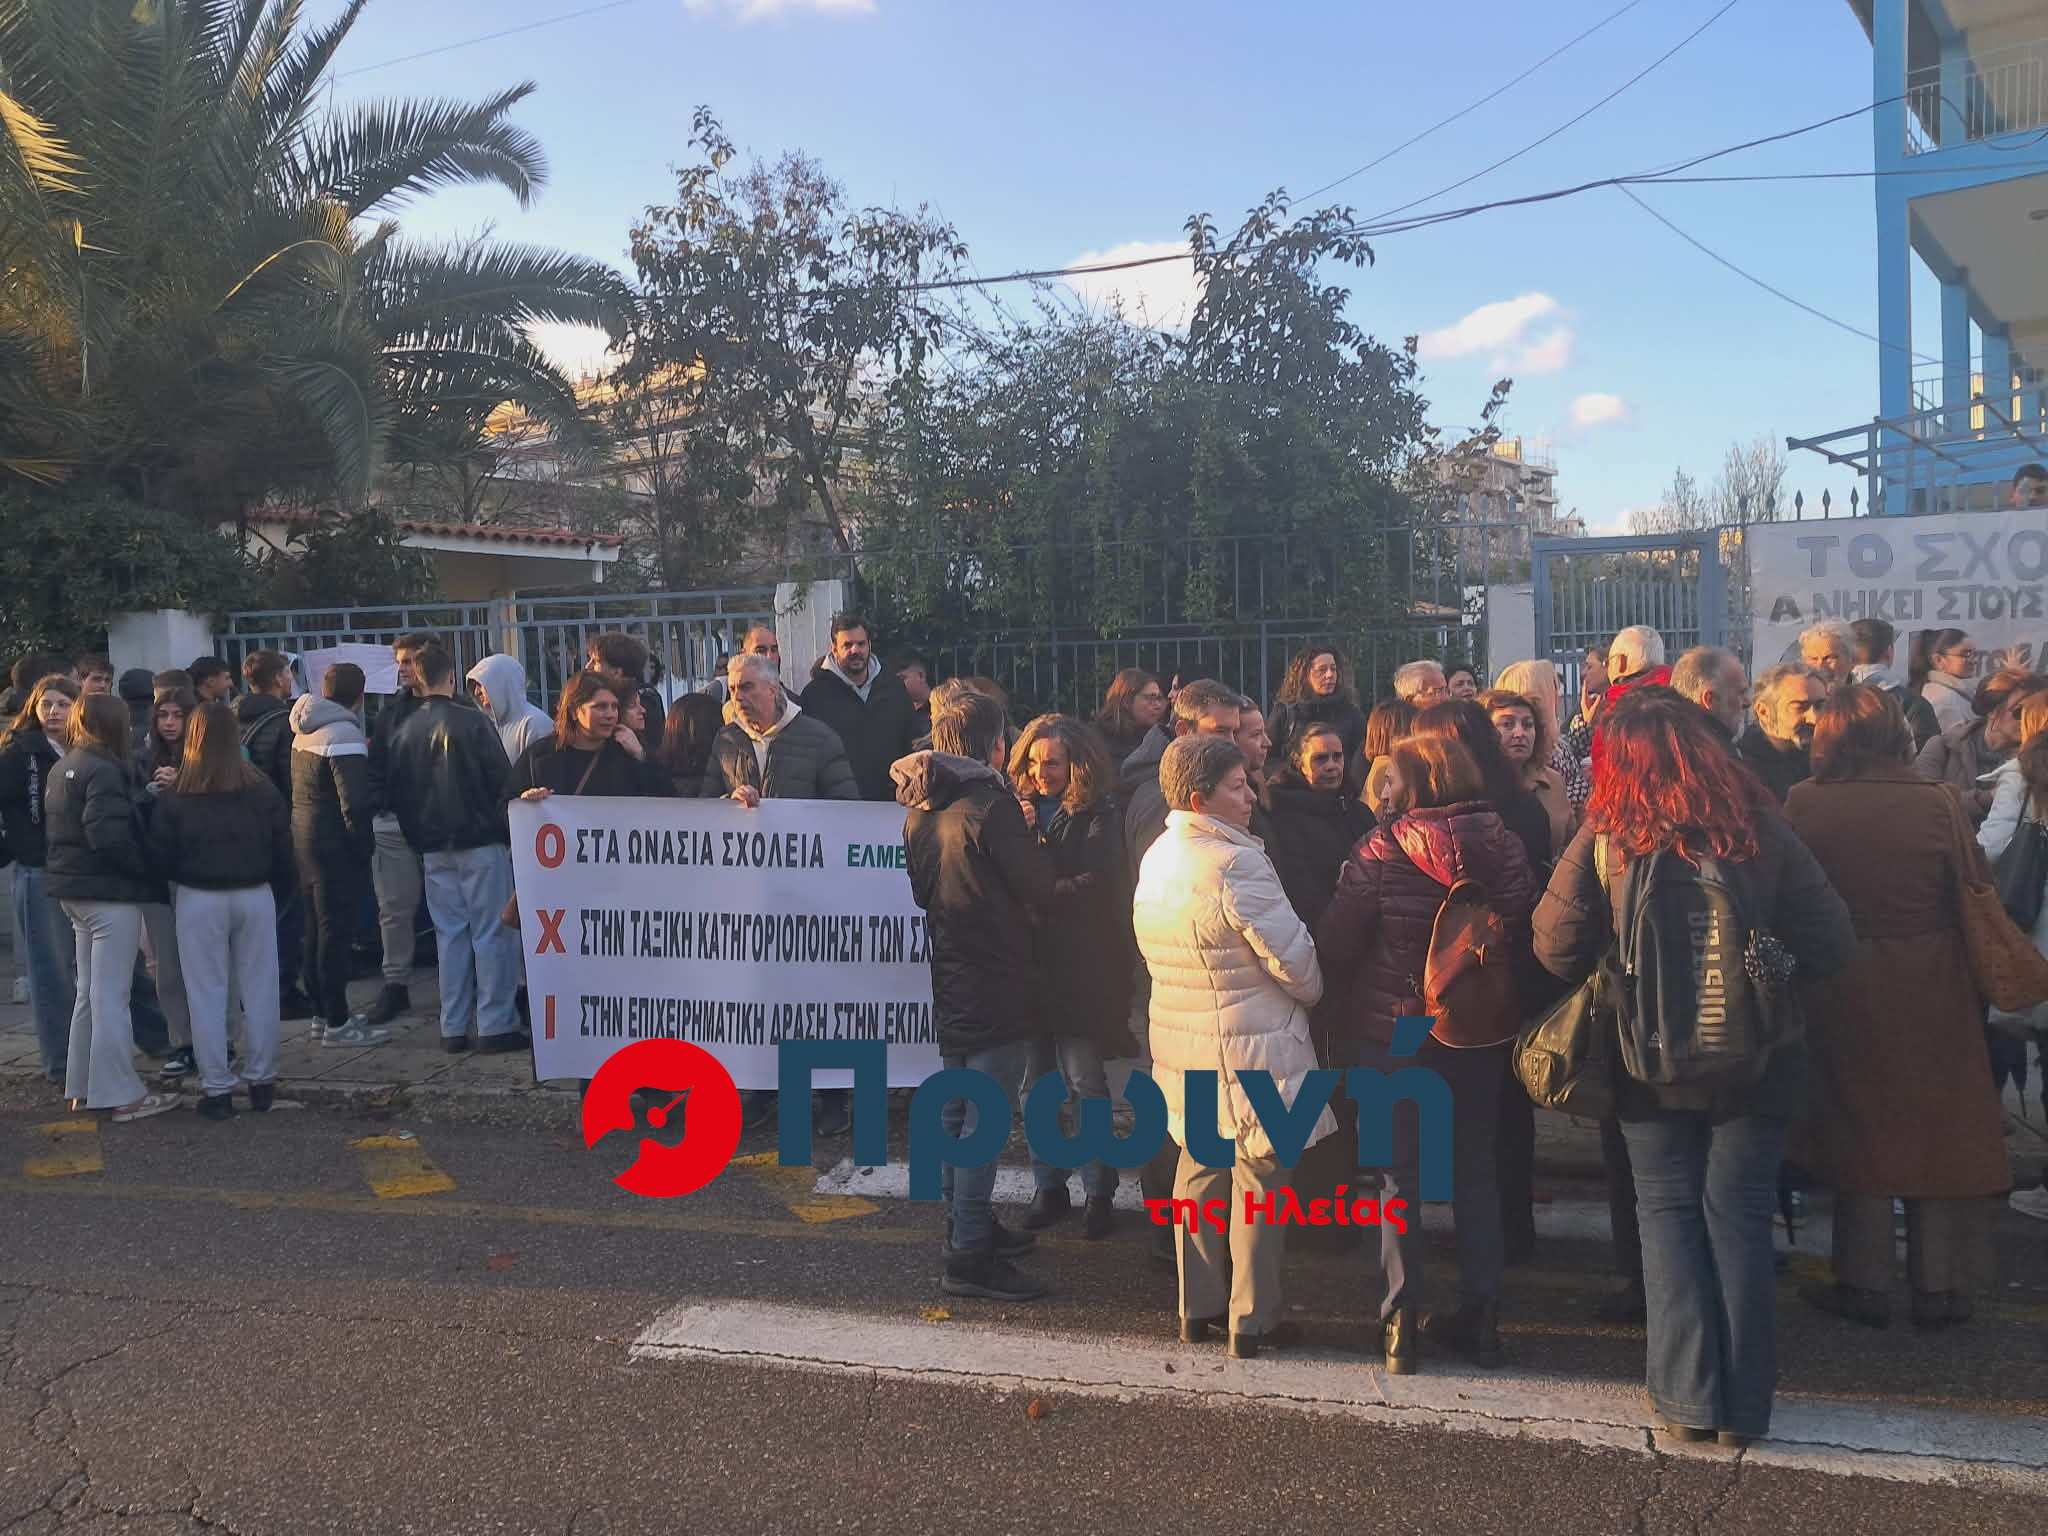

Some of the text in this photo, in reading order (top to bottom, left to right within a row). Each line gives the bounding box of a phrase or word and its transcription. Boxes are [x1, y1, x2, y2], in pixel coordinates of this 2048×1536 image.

[1797, 533, 1893, 579] ΤΟ
[1936, 584, 2043, 621] ΣΤΟΥΣ
[576, 829, 619, 864] ΣΤΑ
[628, 830, 714, 866] ΩΝΑΣΙΑ
[722, 832, 824, 869] ΣΧΟΛΕΙΑ
[847, 843, 907, 869] ΕΛΜΕ
[580, 909, 625, 956] ΣΤΗΝ
[630, 910, 692, 959] ΤΑΞΙΚΗ
[697, 911, 863, 963] ΚΑΤΗΓΟΡΙΟΠΟΙΗΣΗ
[868, 915, 904, 963] ΤΩΝ
[580, 995, 623, 1039] ΣΤΗΝ
[628, 997, 765, 1045] ΕΠΙΧΕΙΡΗΜΑΤΙΚΗ
[769, 1002, 828, 1046] ΔΡΑΣΗ
[833, 1002, 879, 1044] ΣΤΗΝ
